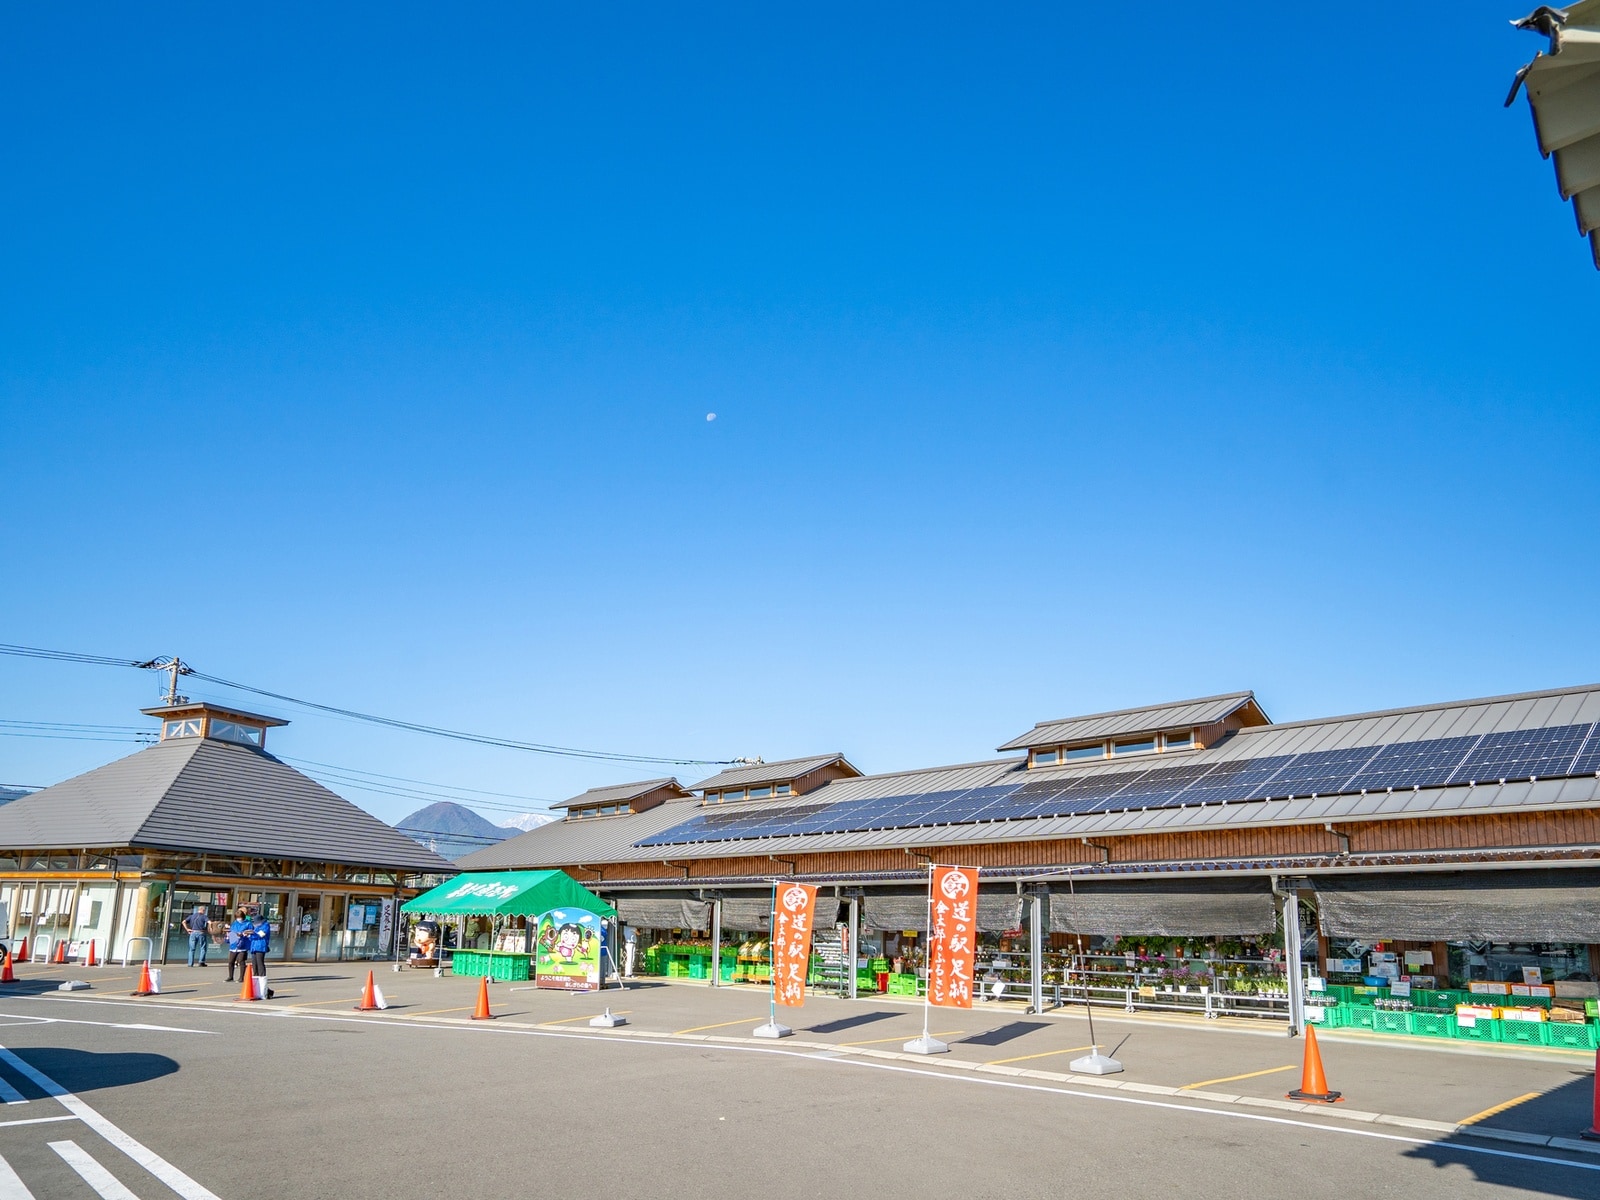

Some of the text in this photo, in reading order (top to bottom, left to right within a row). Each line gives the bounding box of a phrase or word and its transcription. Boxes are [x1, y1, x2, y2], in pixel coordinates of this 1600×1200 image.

[934, 900, 950, 1002] 金太郎のふるさと
